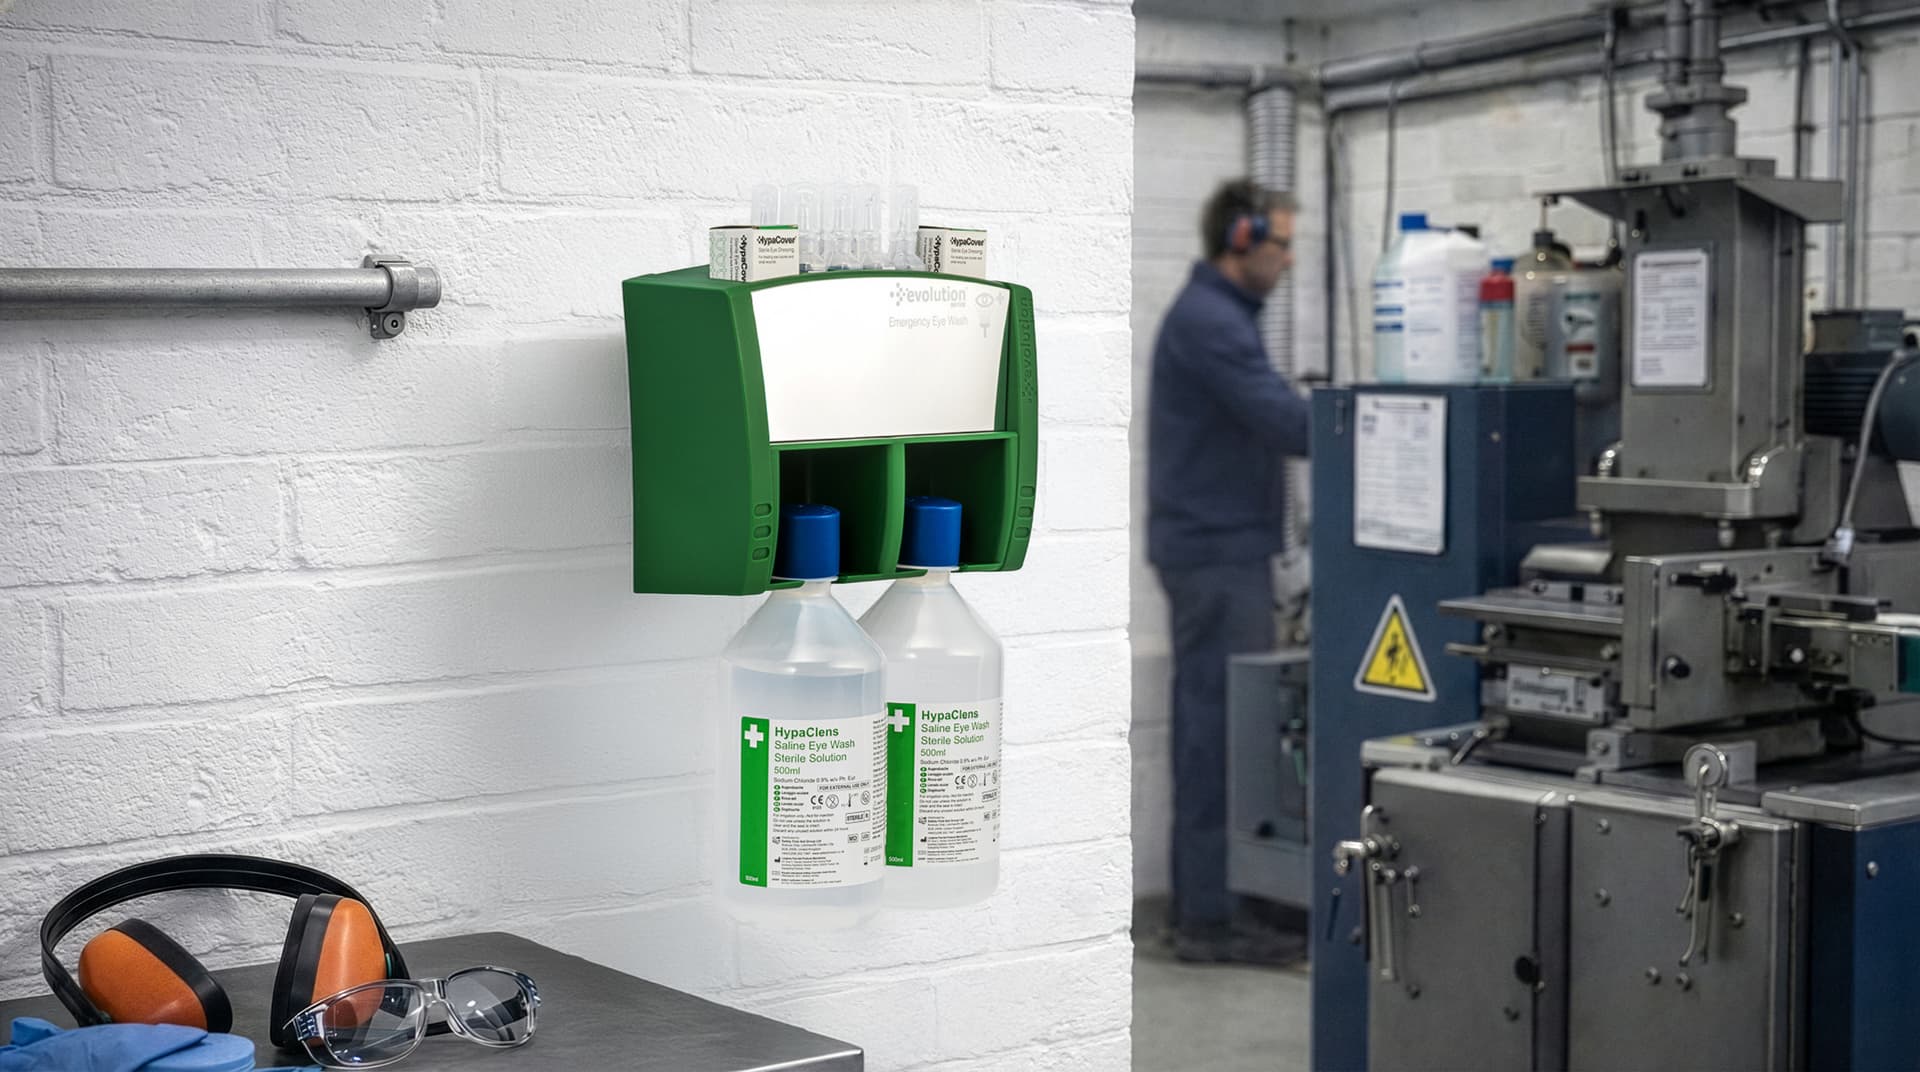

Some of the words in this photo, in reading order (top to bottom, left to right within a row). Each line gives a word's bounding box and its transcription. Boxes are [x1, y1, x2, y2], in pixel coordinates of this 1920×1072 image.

[757, 235, 796, 246] HypaCover
[950, 236, 985, 247] HypaCover
[739, 235, 748, 282] HypaCov
[906, 285, 967, 303] evolution
[921, 710, 979, 722] HypaClens
[774, 726, 839, 739] HypaClens
[921, 723, 951, 733] Saline
[953, 723, 969, 734] Eye
[971, 720, 990, 730] Wash
[774, 740, 806, 750] Saline
[808, 740, 828, 752] Eye
[830, 738, 856, 749] Wash
[921, 735, 951, 745] Sterile
[954, 733, 984, 744] Solution
[774, 752, 806, 763] Sterile
[809, 752, 847, 763] Solution
[920, 748, 946, 756] 500ml
[774, 766, 800, 775] 500ml
